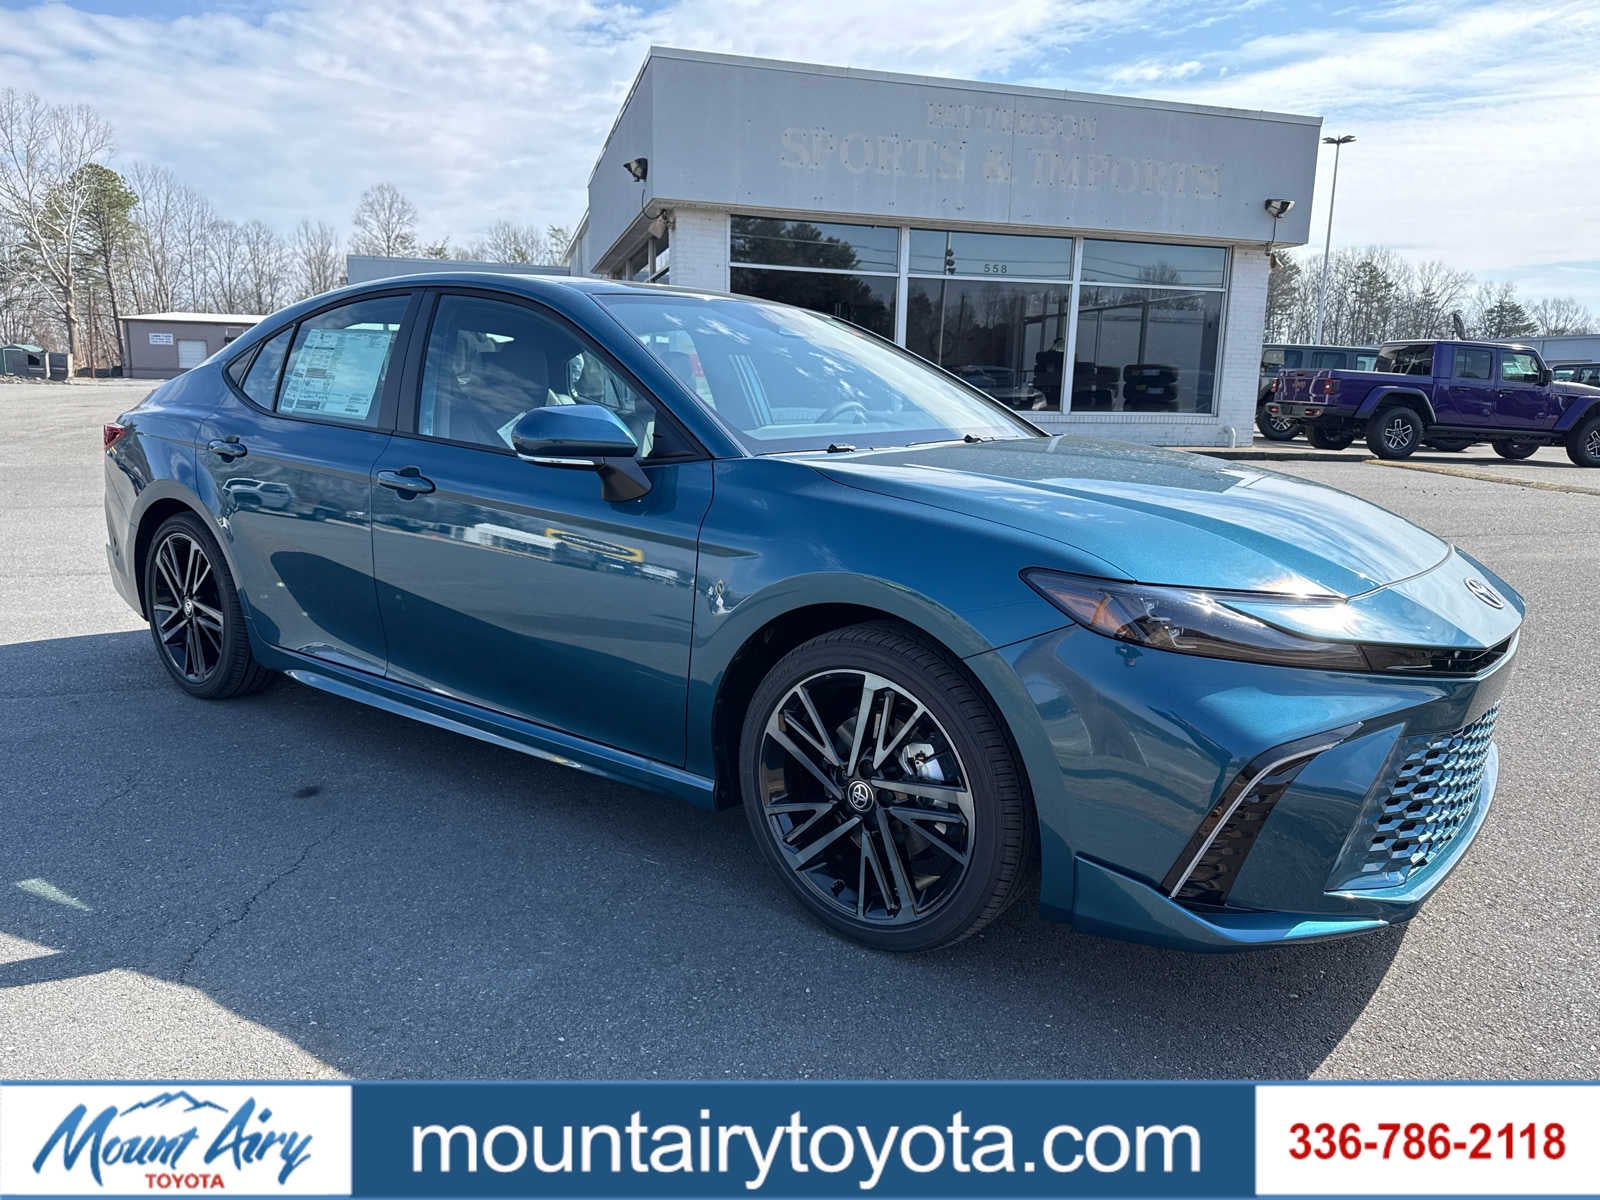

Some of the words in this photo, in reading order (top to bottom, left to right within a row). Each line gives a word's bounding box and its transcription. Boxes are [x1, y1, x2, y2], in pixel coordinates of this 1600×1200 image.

[780, 127, 967, 181] SPORTS
[982, 147, 1015, 184] &
[1031, 147, 1223, 200] IMPORTS
[983, 263, 1008, 274] 558
